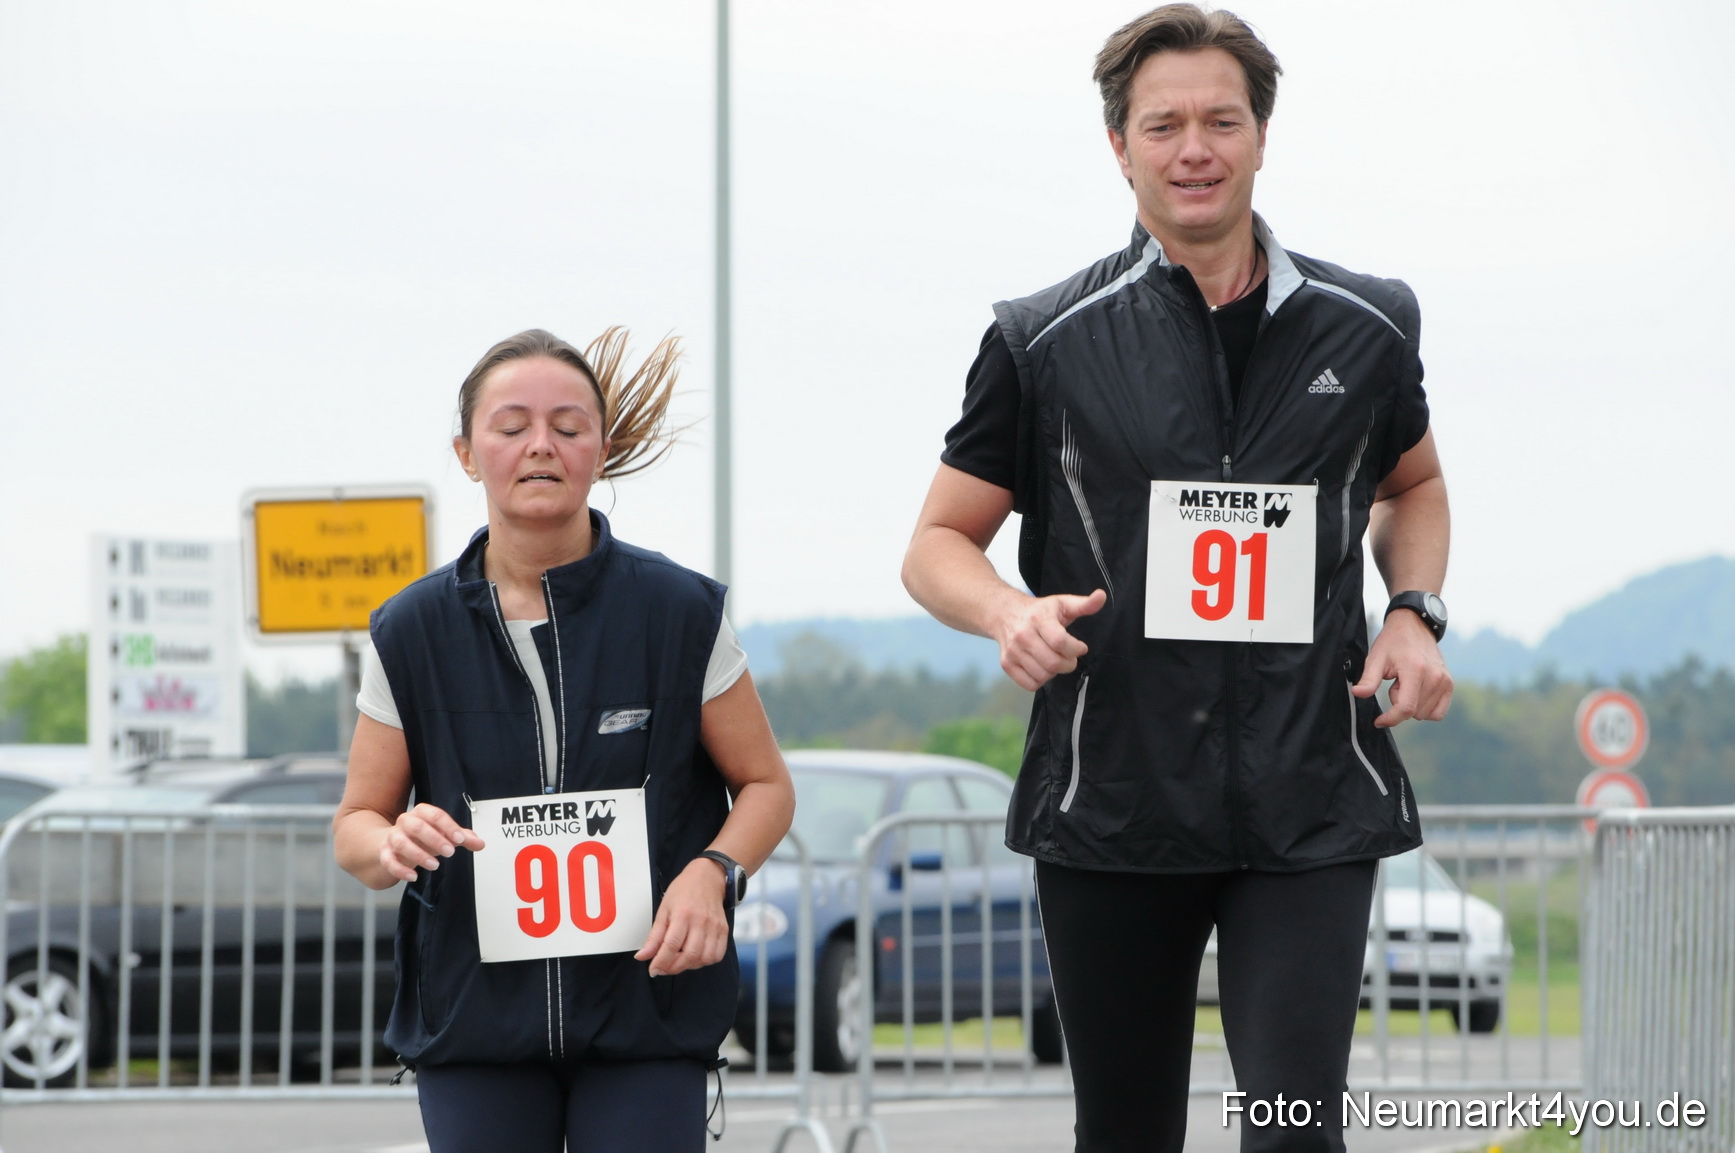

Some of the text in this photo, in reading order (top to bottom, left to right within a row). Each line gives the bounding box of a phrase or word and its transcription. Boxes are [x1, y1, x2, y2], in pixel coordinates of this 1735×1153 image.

[1308, 384, 1345, 393] adidas
[1179, 489, 1258, 509] MEYER
[1179, 508, 1258, 524] WERBUNG
[270, 547, 413, 577] Neumarkt
[1191, 529, 1268, 621] 91
[501, 802, 579, 824] MEYER
[502, 822, 581, 838] WERBUNG
[514, 840, 617, 938] 90
